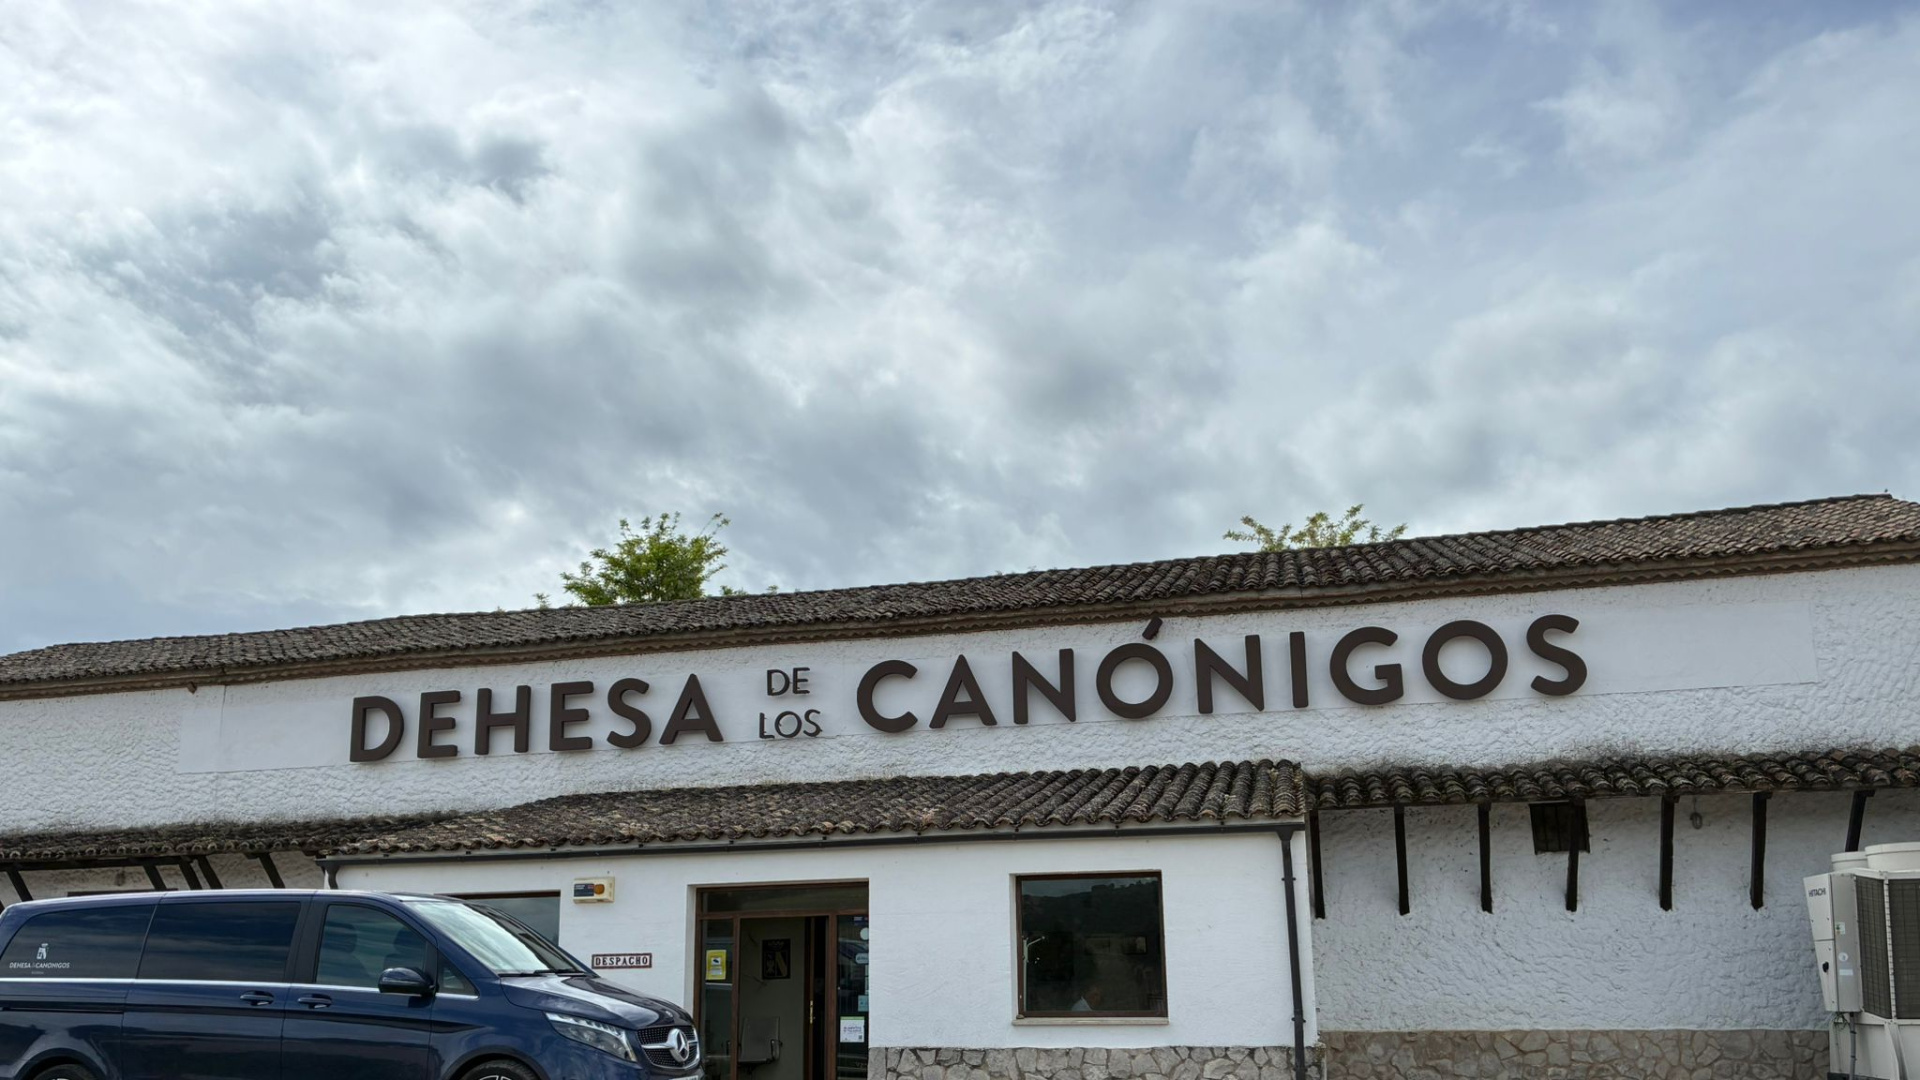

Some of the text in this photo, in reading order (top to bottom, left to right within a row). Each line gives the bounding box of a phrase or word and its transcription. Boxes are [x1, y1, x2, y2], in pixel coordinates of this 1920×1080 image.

[766, 667, 810, 697] DE
[857, 614, 1588, 733] CANÓNIGOS
[349, 673, 723, 762] DEHESA
[759, 709, 822, 740] LOS
[1809, 888, 1826, 897] HITACHI
[595, 956, 648, 966] DESPACHO
